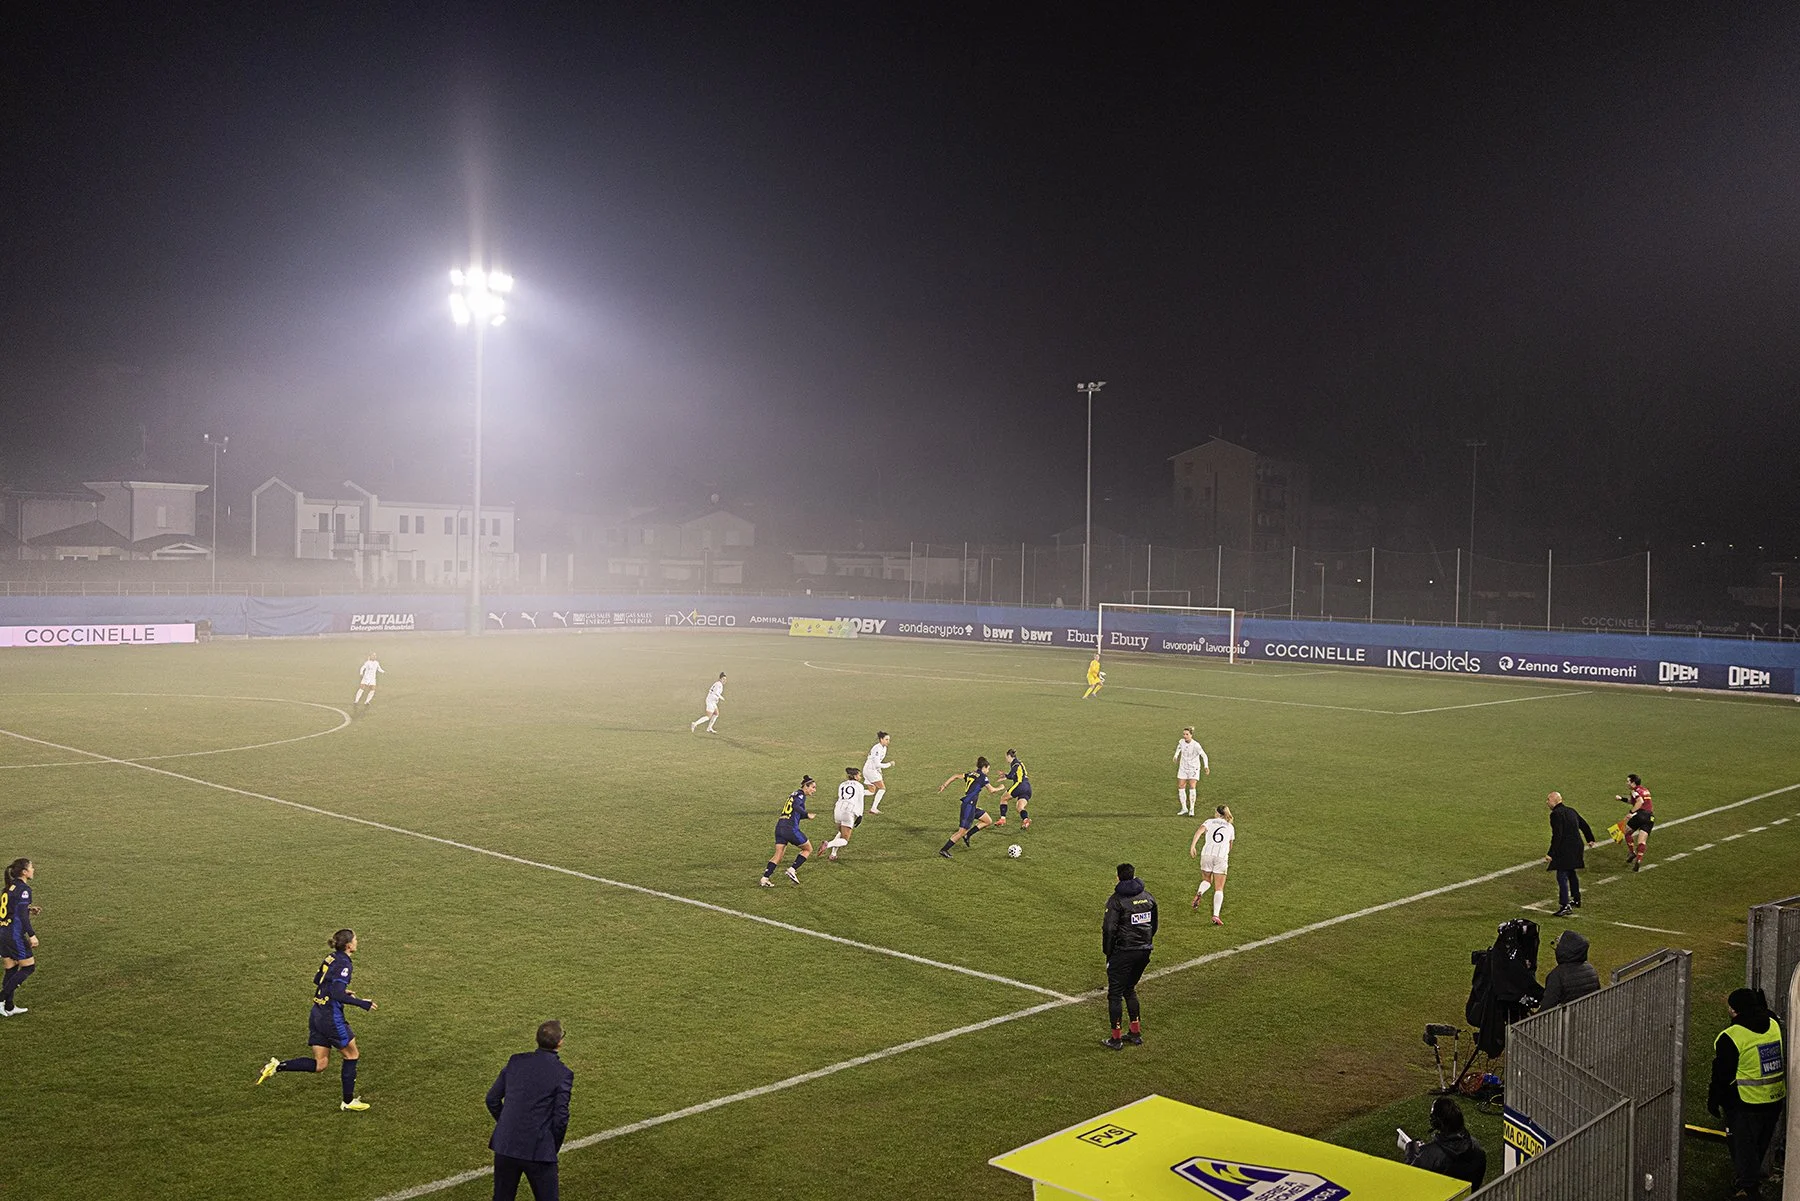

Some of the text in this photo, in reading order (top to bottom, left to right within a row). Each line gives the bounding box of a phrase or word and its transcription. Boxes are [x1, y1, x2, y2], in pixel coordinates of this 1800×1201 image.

[351, 614, 414, 625] PULITALIA
[25, 628, 155, 643] COCCINELLE
[899, 622, 964, 637] zondacrypto
[992, 629, 1014, 639] BWT
[1030, 630, 1053, 642] BWT
[1111, 632, 1149, 650] Ebury
[1265, 643, 1365, 662] COCCINELLE
[1387, 649, 1481, 673] INCHotels
[1517, 658, 1637, 678] Zenna Serramenti
[1659, 661, 1699, 681] OPEM
[1728, 665, 1770, 686] OPEM
[840, 785, 856, 800] 19
[1212, 825, 1226, 844] 6
[1089, 1128, 1125, 1144] FVS
